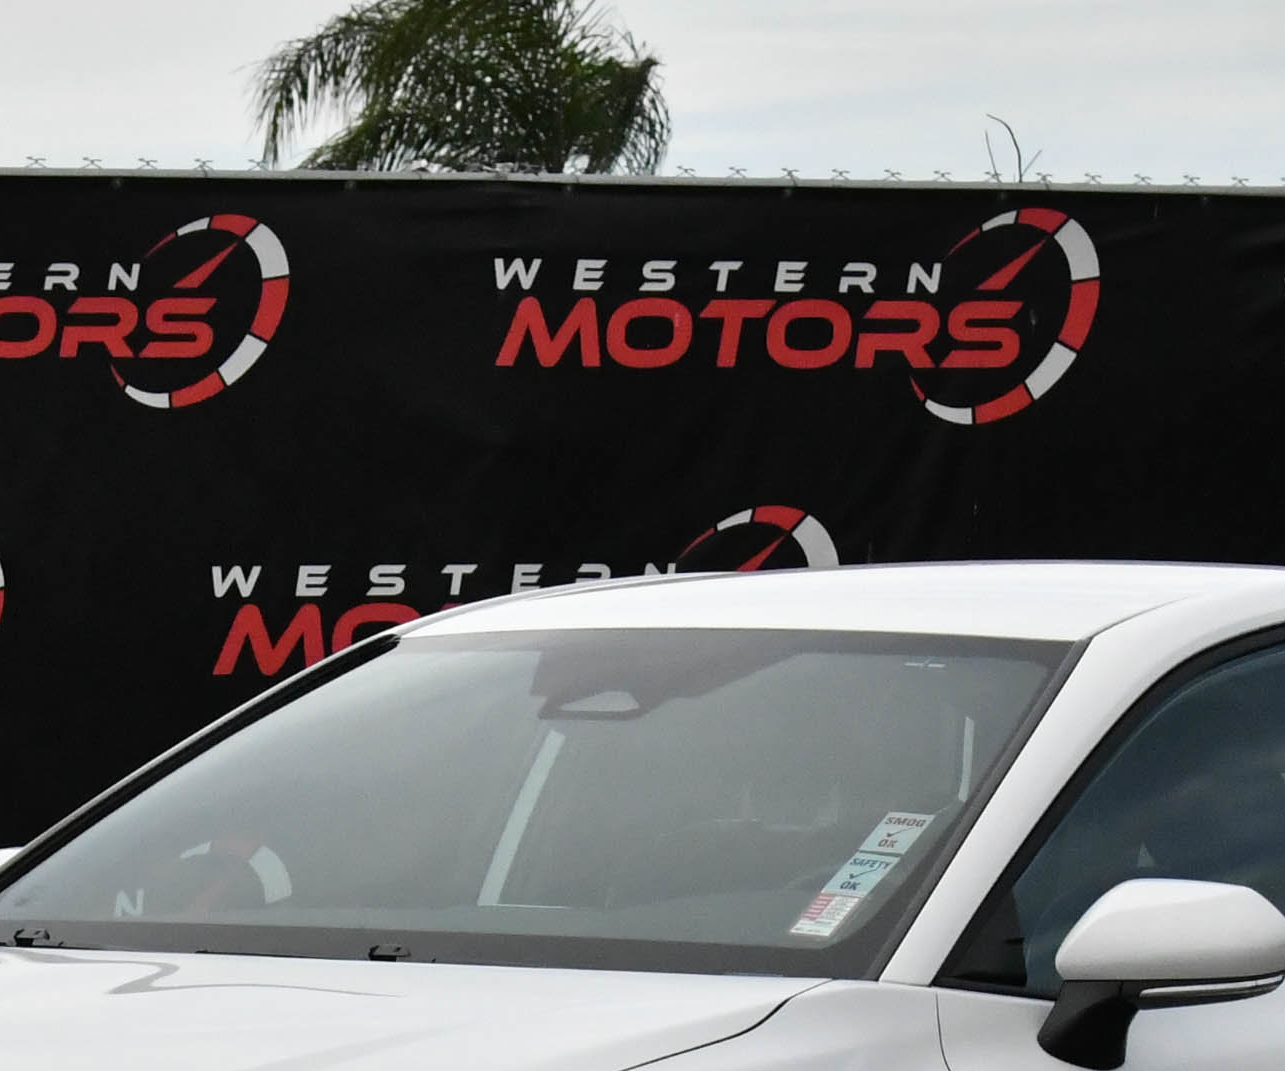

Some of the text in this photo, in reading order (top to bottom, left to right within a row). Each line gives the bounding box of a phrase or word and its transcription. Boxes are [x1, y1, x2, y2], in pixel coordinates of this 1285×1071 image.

[495, 258, 942, 294] WESTERN
[496, 296, 1023, 369] MOTORS
[884, 816, 926, 828] SMOG
[877, 838, 899, 849] OK
[849, 857, 893, 870] SAFETY
[839, 880, 861, 891] OK
